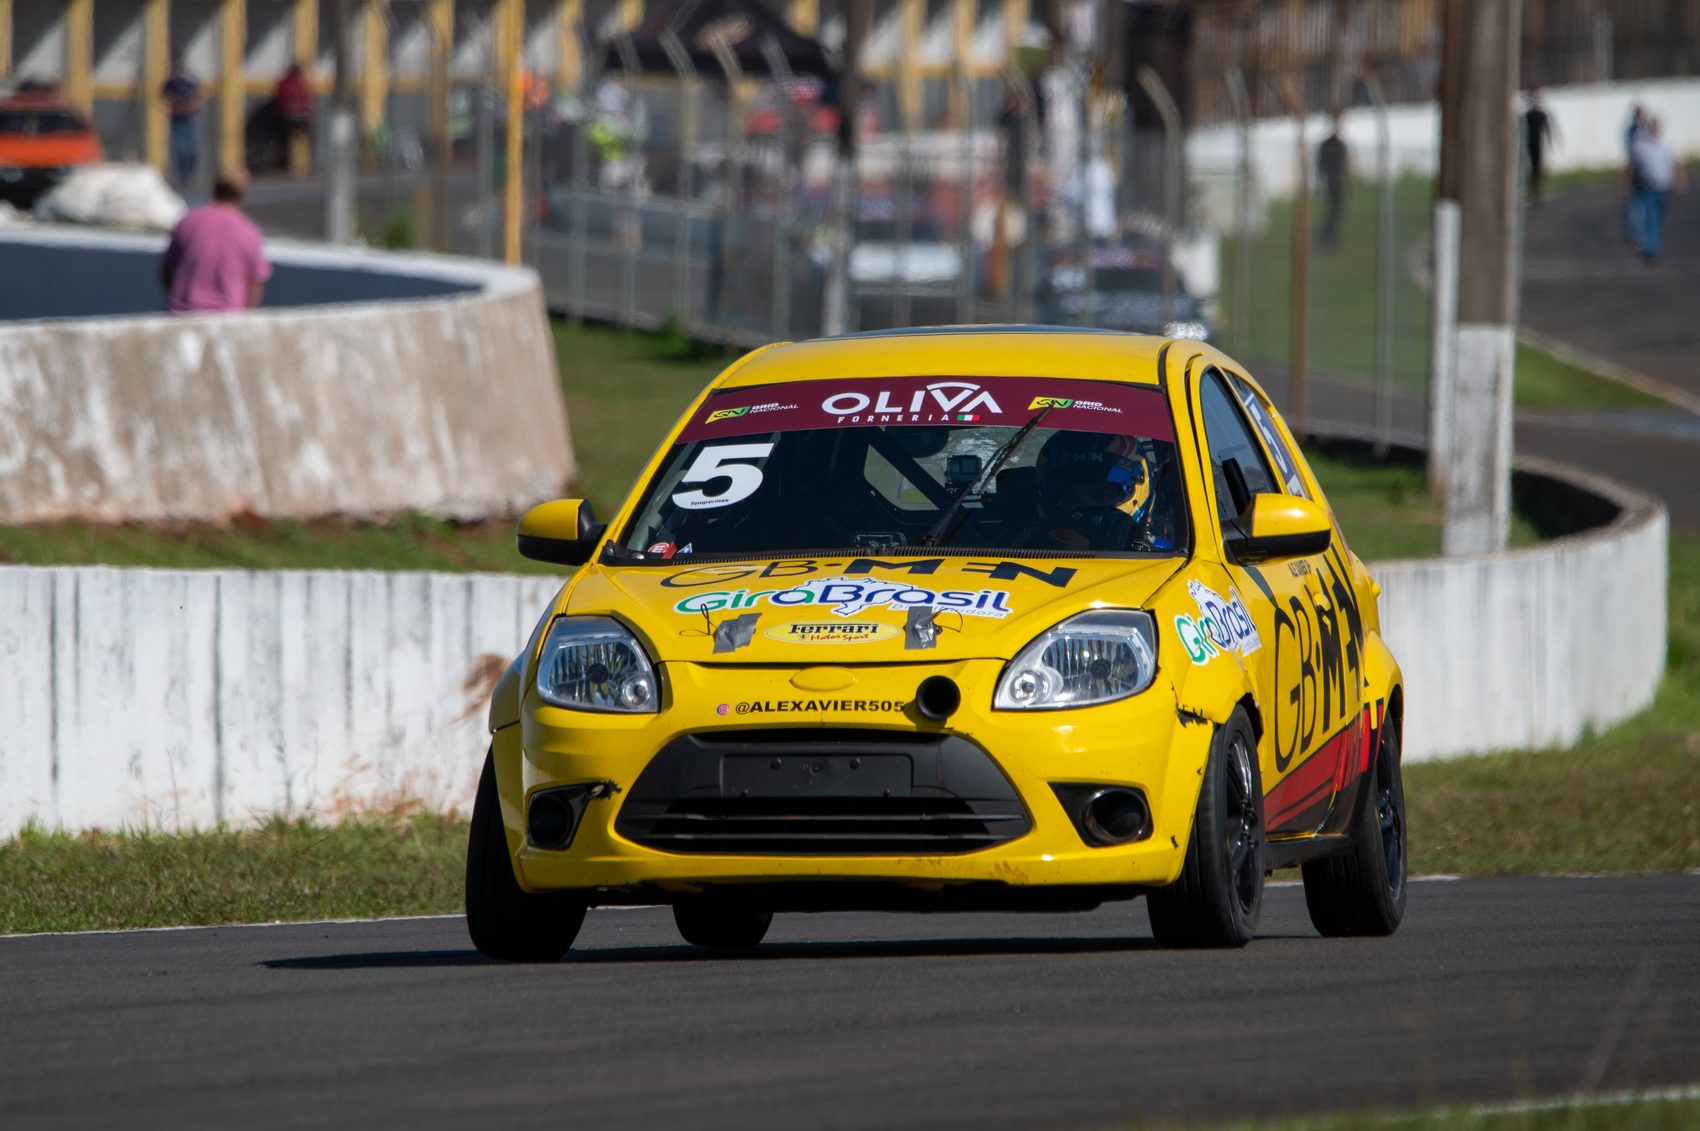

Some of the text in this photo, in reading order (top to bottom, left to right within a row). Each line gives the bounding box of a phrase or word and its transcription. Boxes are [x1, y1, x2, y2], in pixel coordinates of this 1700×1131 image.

[822, 382, 1003, 414] OLIVA
[750, 404, 799, 413] NACIONAL
[1073, 404, 1123, 413] NACIONAL
[837, 414, 949, 424] FORNERIA
[672, 443, 774, 509] 5
[788, 623, 879, 634] Ferrari
[735, 700, 905, 715] @ALEXAVIER505
